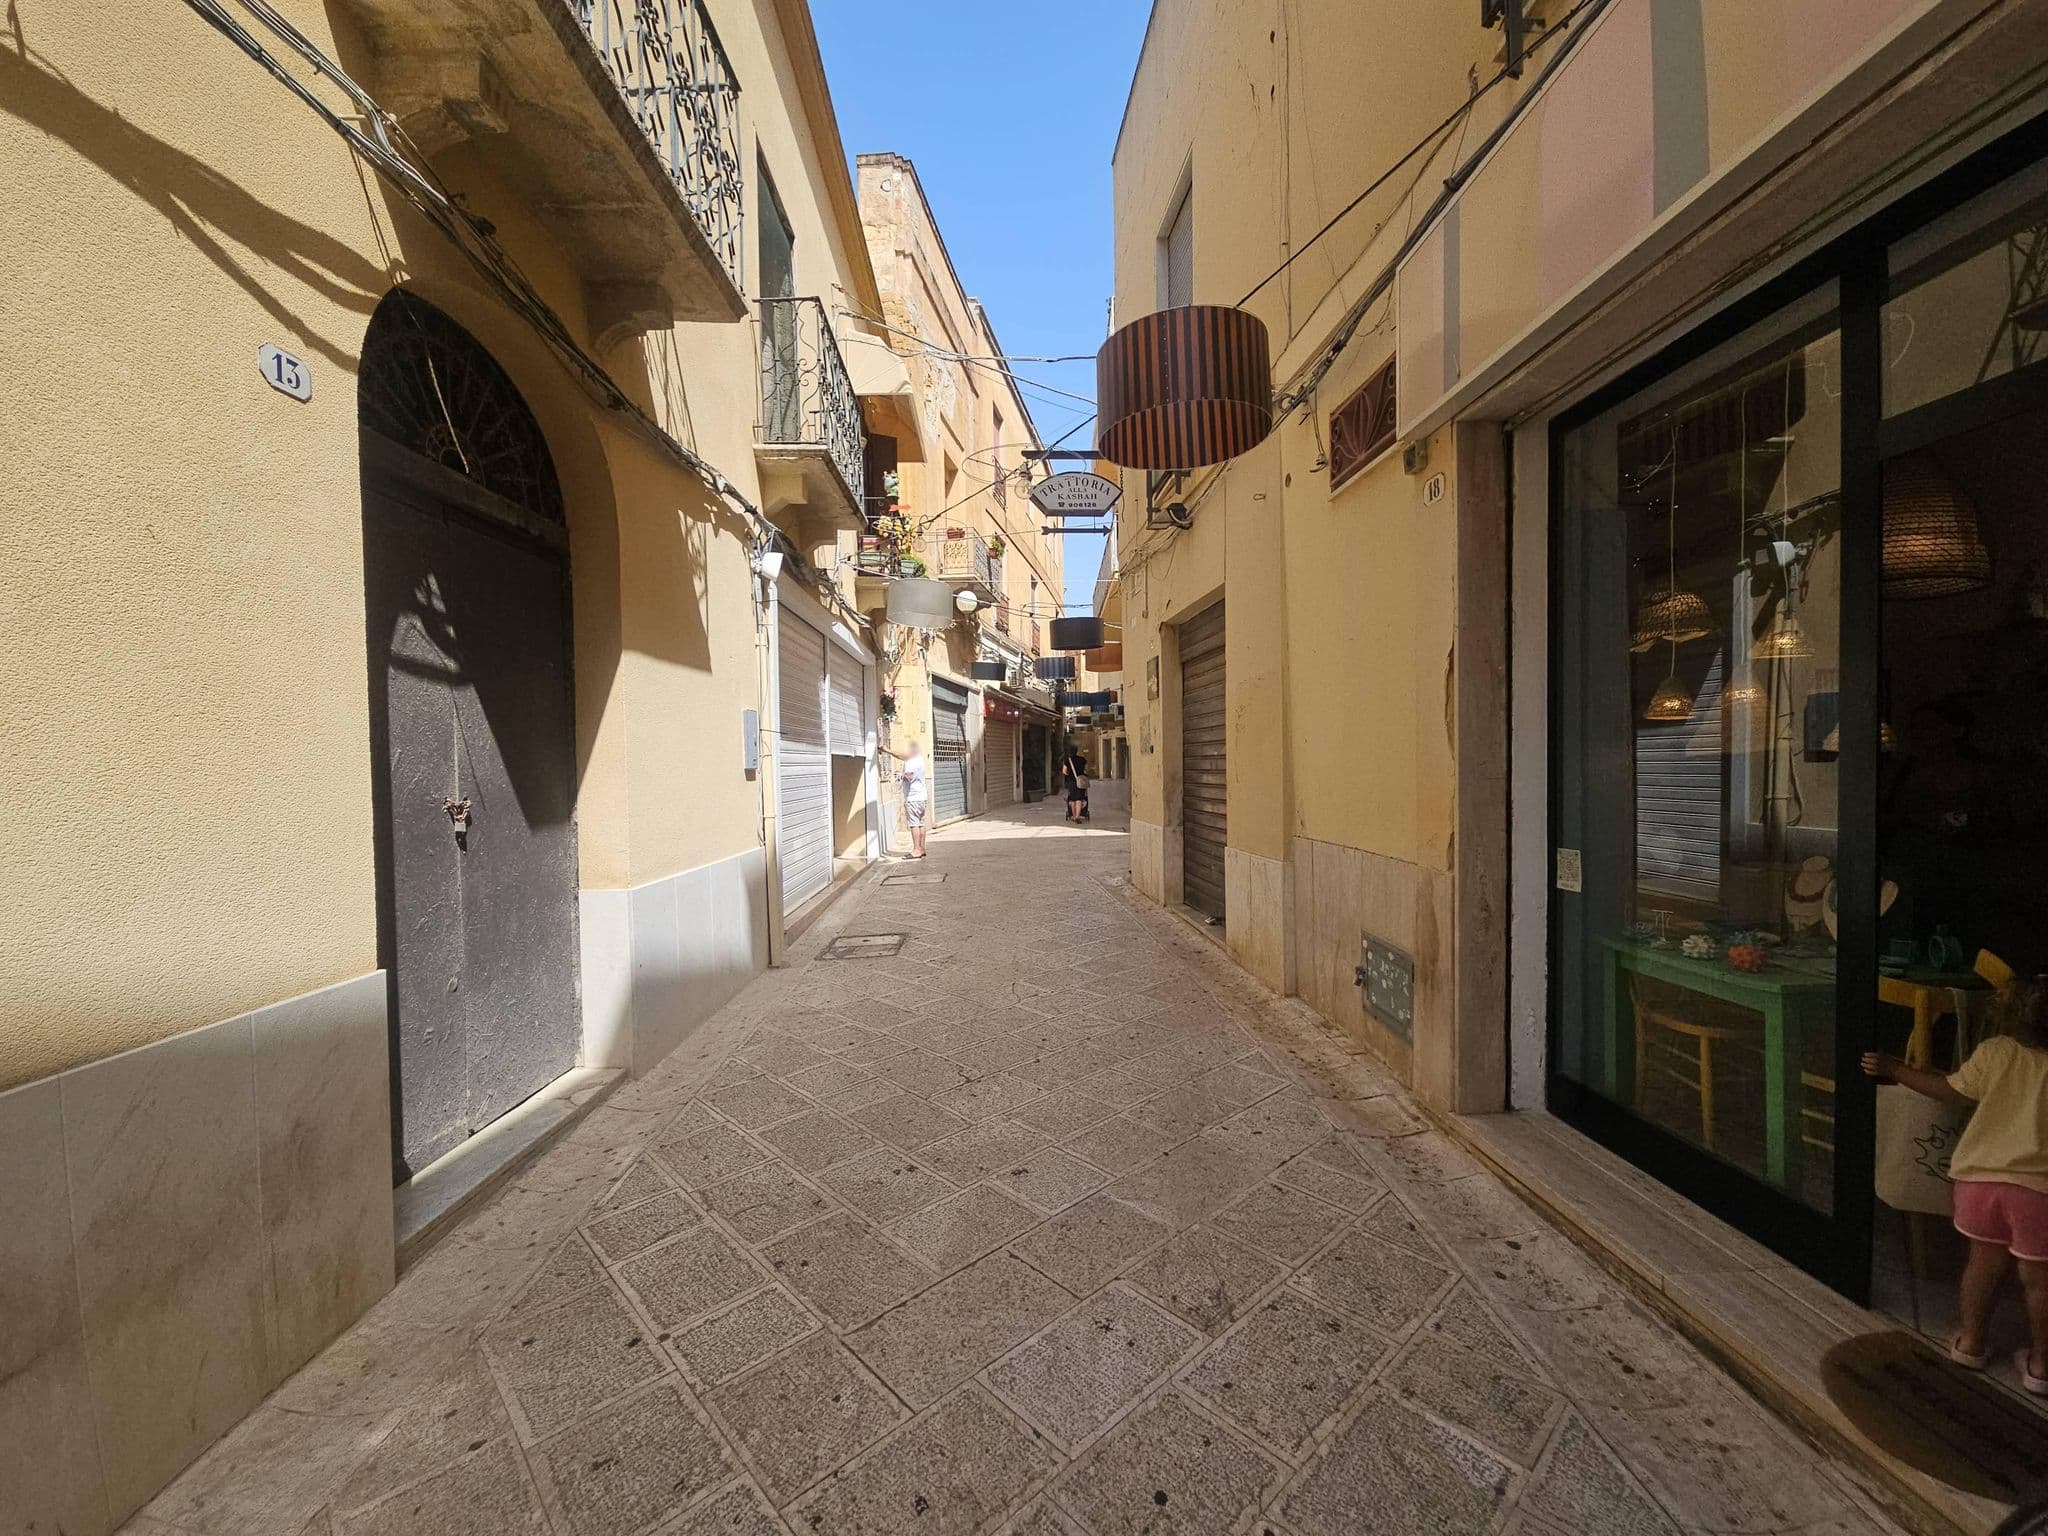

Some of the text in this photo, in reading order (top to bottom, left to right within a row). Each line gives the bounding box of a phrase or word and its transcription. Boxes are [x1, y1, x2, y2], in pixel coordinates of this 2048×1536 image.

[271, 352, 301, 390] 13
[1039, 475, 1111, 497] TRATTORIA
[1428, 477, 1441, 502] 18
